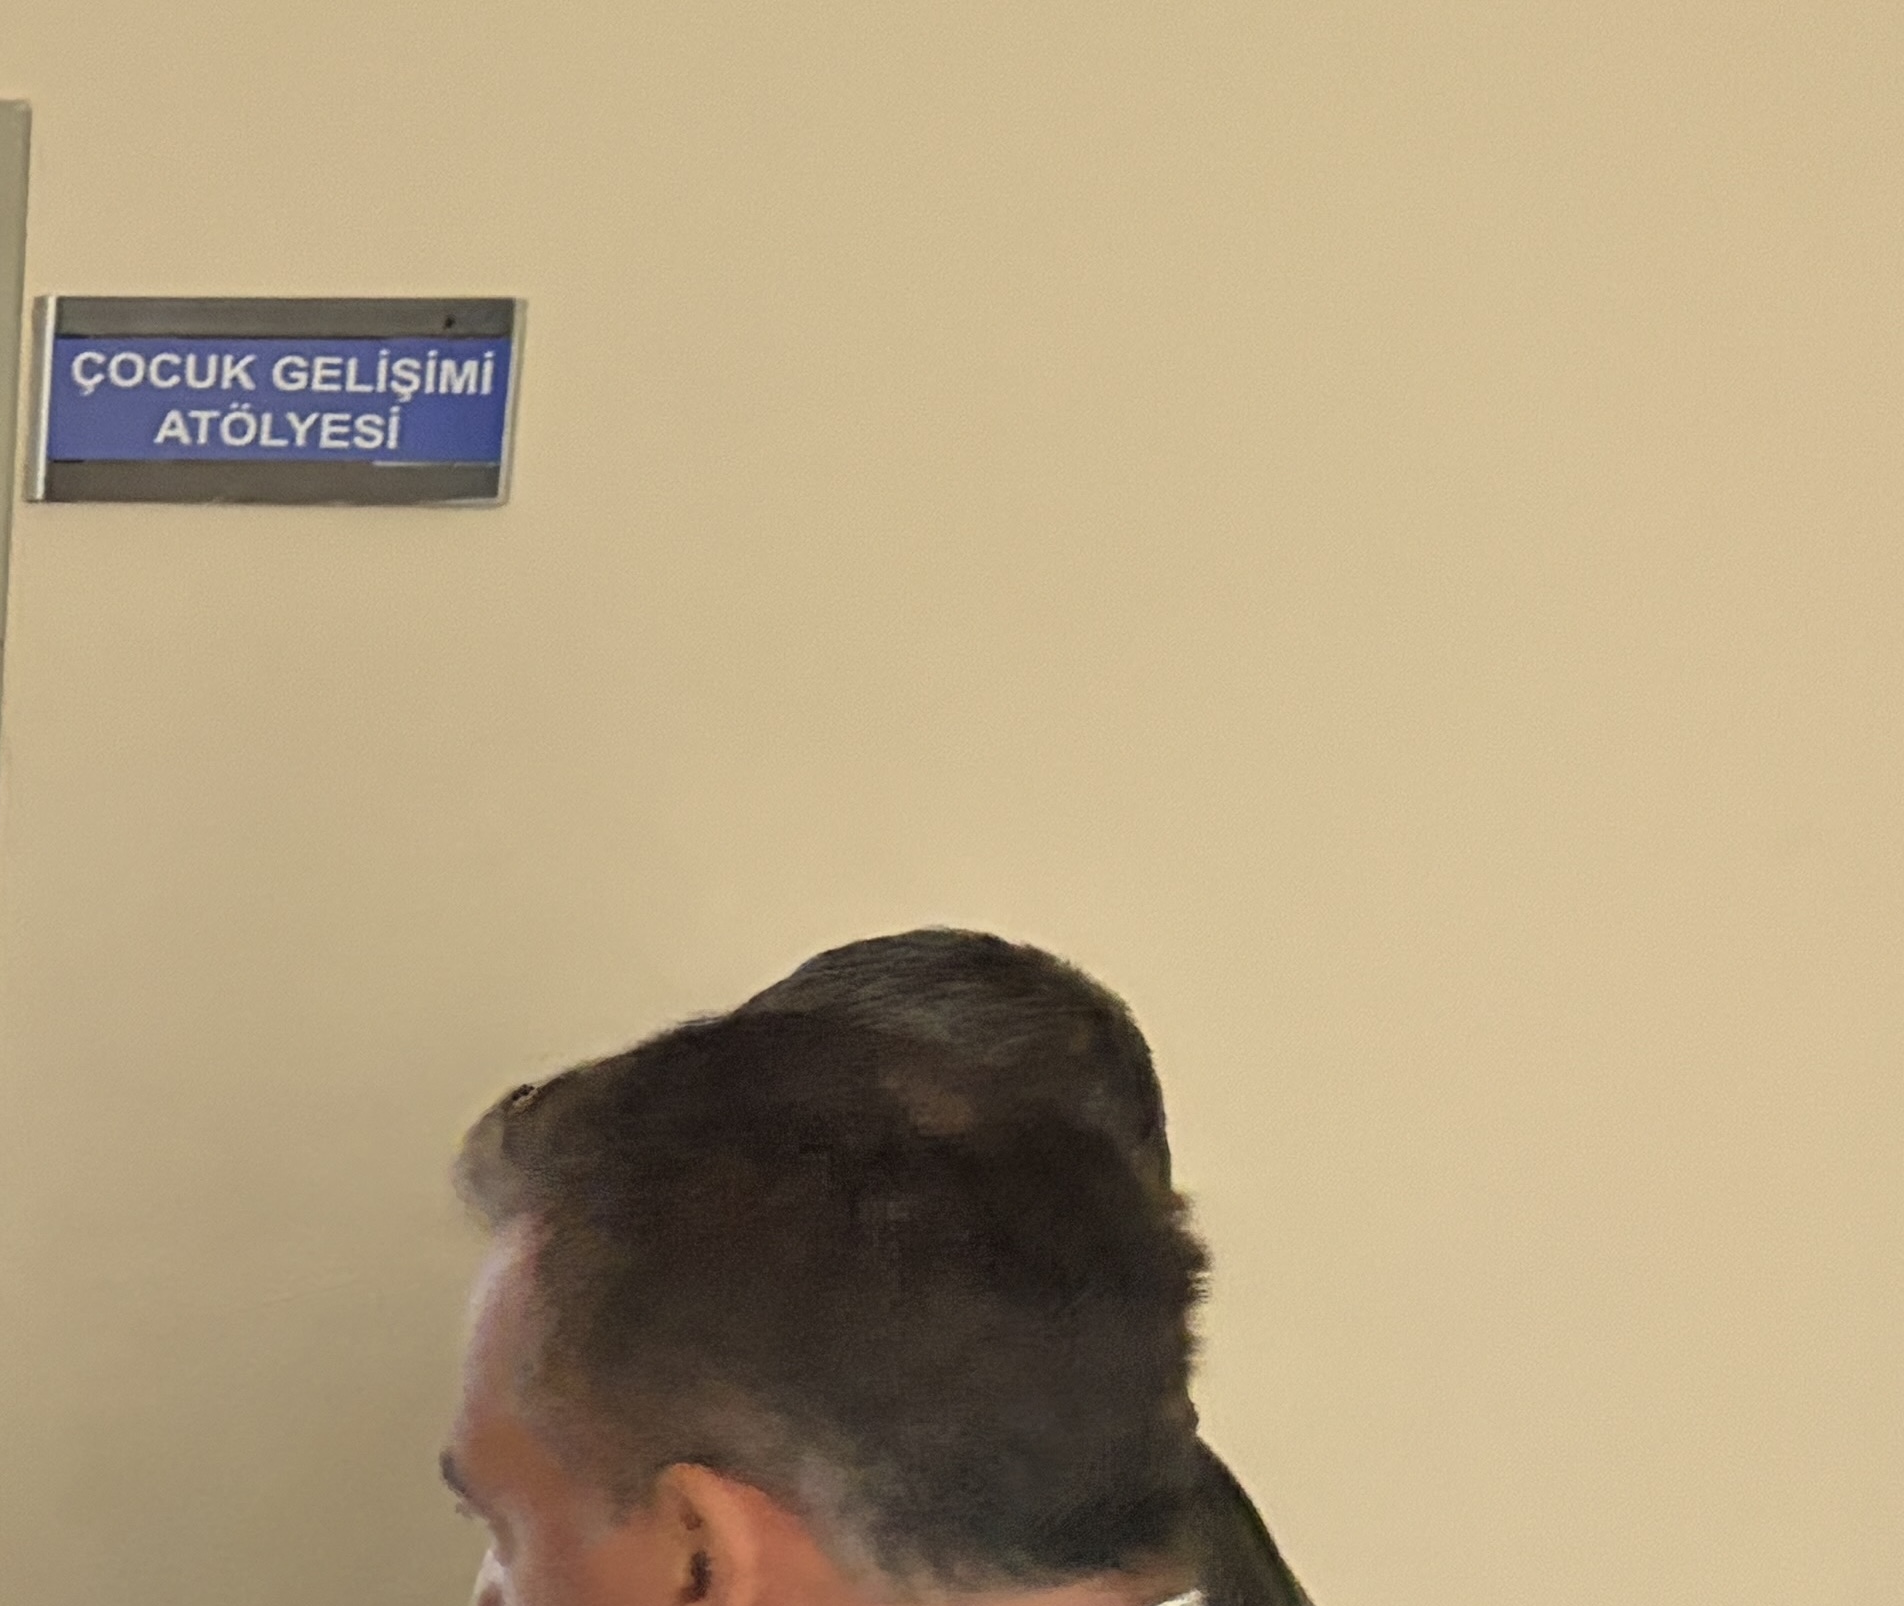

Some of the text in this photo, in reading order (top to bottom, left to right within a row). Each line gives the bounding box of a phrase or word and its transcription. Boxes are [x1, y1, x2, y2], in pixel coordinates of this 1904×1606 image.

[71, 348, 496, 403] ÇOCUK GELİŞİMİ
[153, 402, 402, 450] ATÖLYESİ
